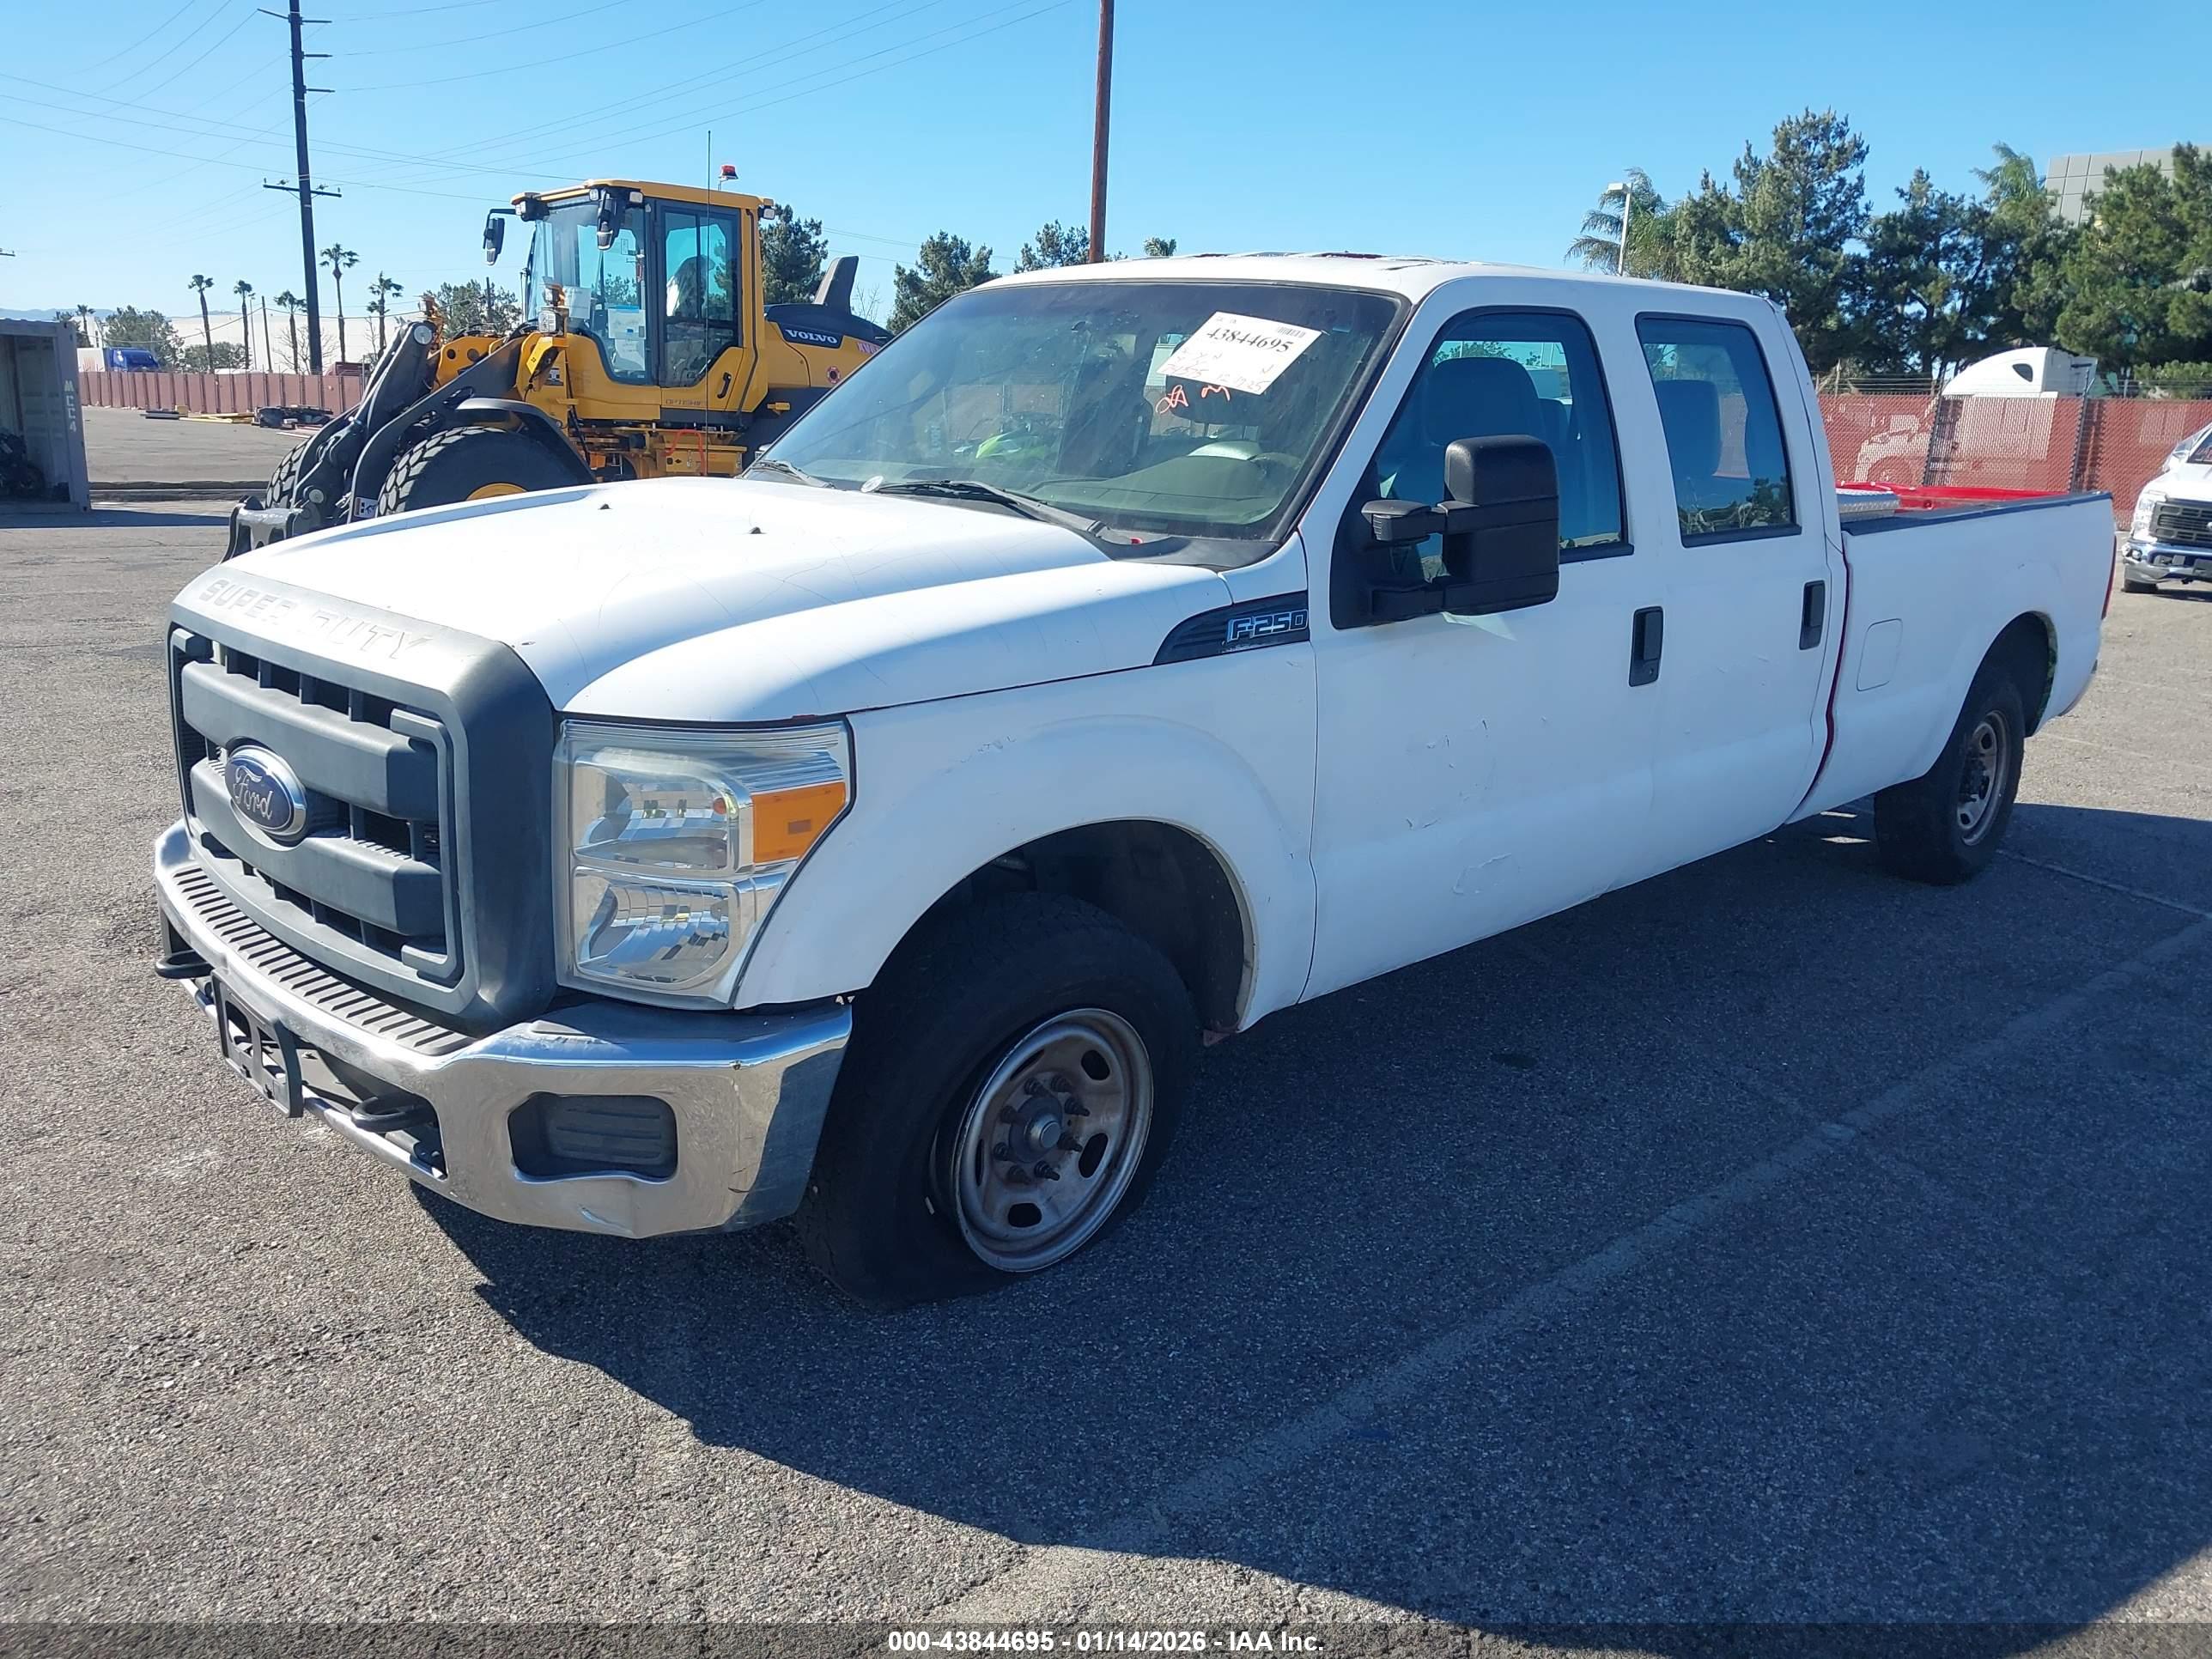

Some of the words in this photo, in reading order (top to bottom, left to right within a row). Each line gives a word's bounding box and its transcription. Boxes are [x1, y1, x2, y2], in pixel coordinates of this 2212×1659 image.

[785, 329, 838, 344] VOLVO
[1206, 327, 1294, 353] 43844695
[198, 579, 298, 628] SUPER
[298, 609, 432, 659] DUTY
[1227, 609, 1309, 642] F-250
[233, 765, 274, 821] Ford
